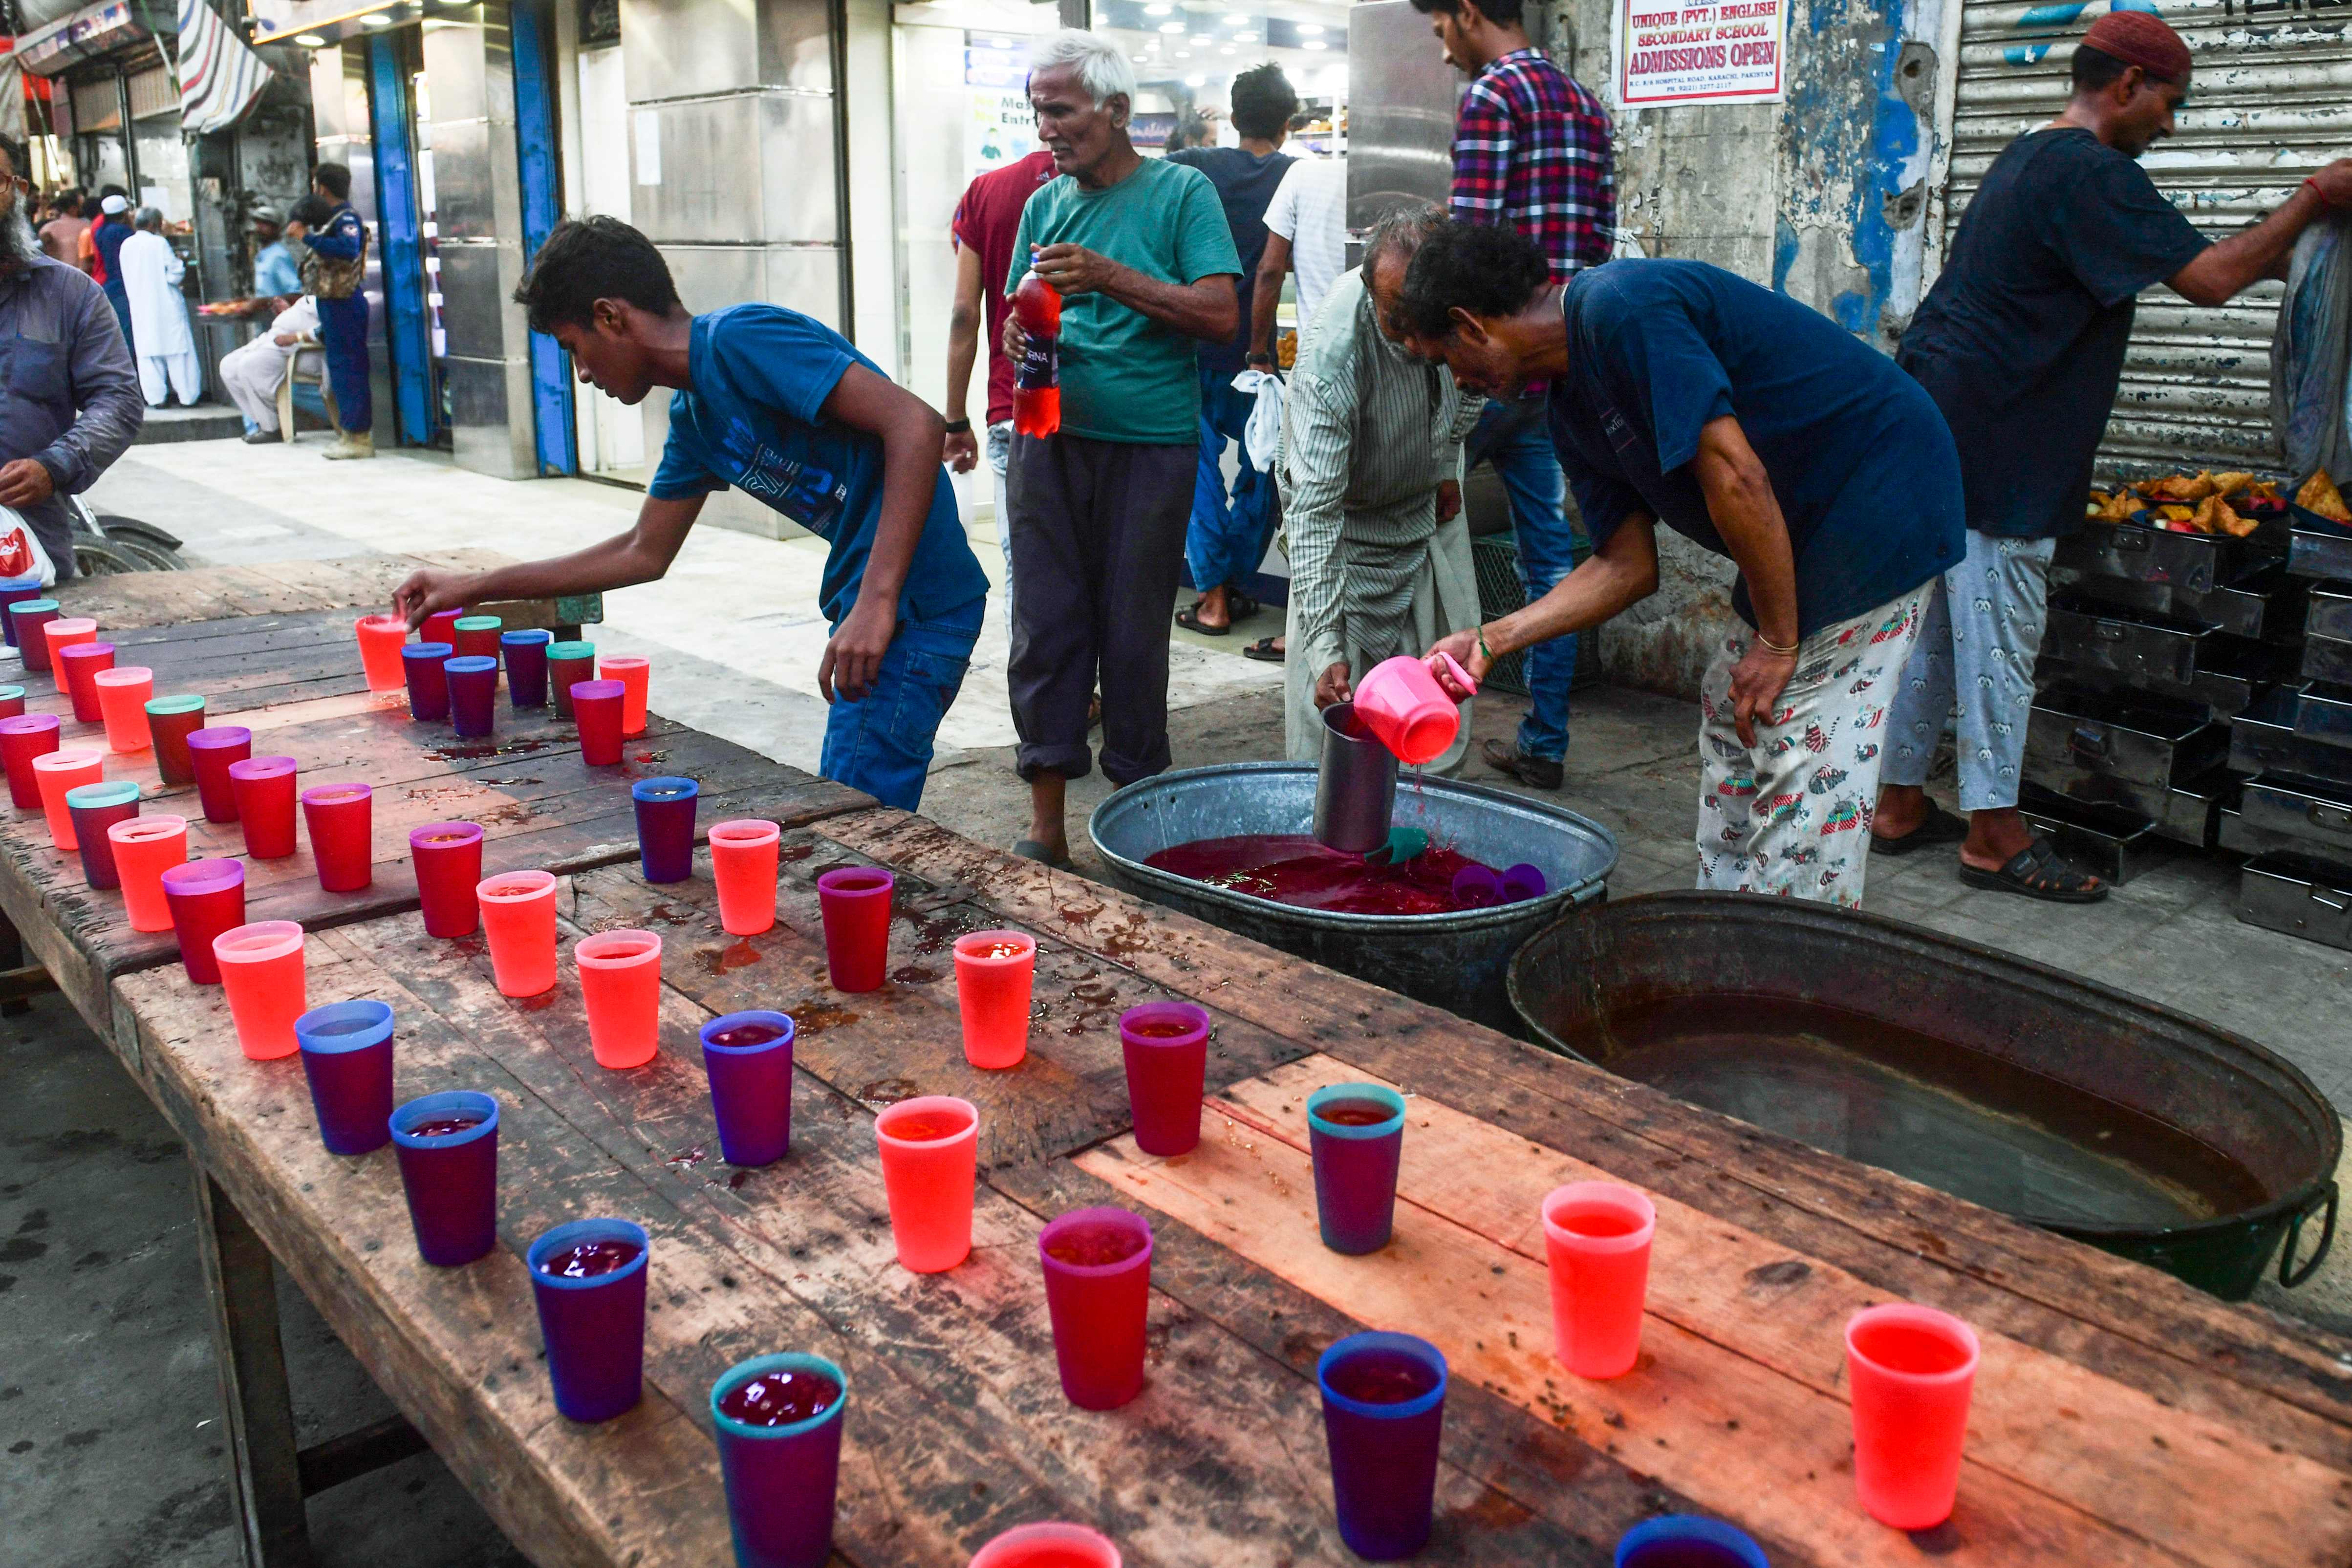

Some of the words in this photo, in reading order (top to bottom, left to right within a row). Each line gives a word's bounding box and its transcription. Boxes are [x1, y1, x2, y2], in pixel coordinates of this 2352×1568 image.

[1632, 12, 1678, 29] UNIQUE
[1682, 7, 1716, 27] (PVT.)
[1720, 1, 1777, 21] ENGLISH
[1638, 28, 1711, 47] SECONDARY
[1716, 22, 1769, 40] SCHOOL
[1629, 45, 1726, 75] ADMISSIONS
[1730, 41, 1776, 67] OPEN
[1001, 97, 1031, 110] Mas
[1001, 113, 1031, 125] Entr
